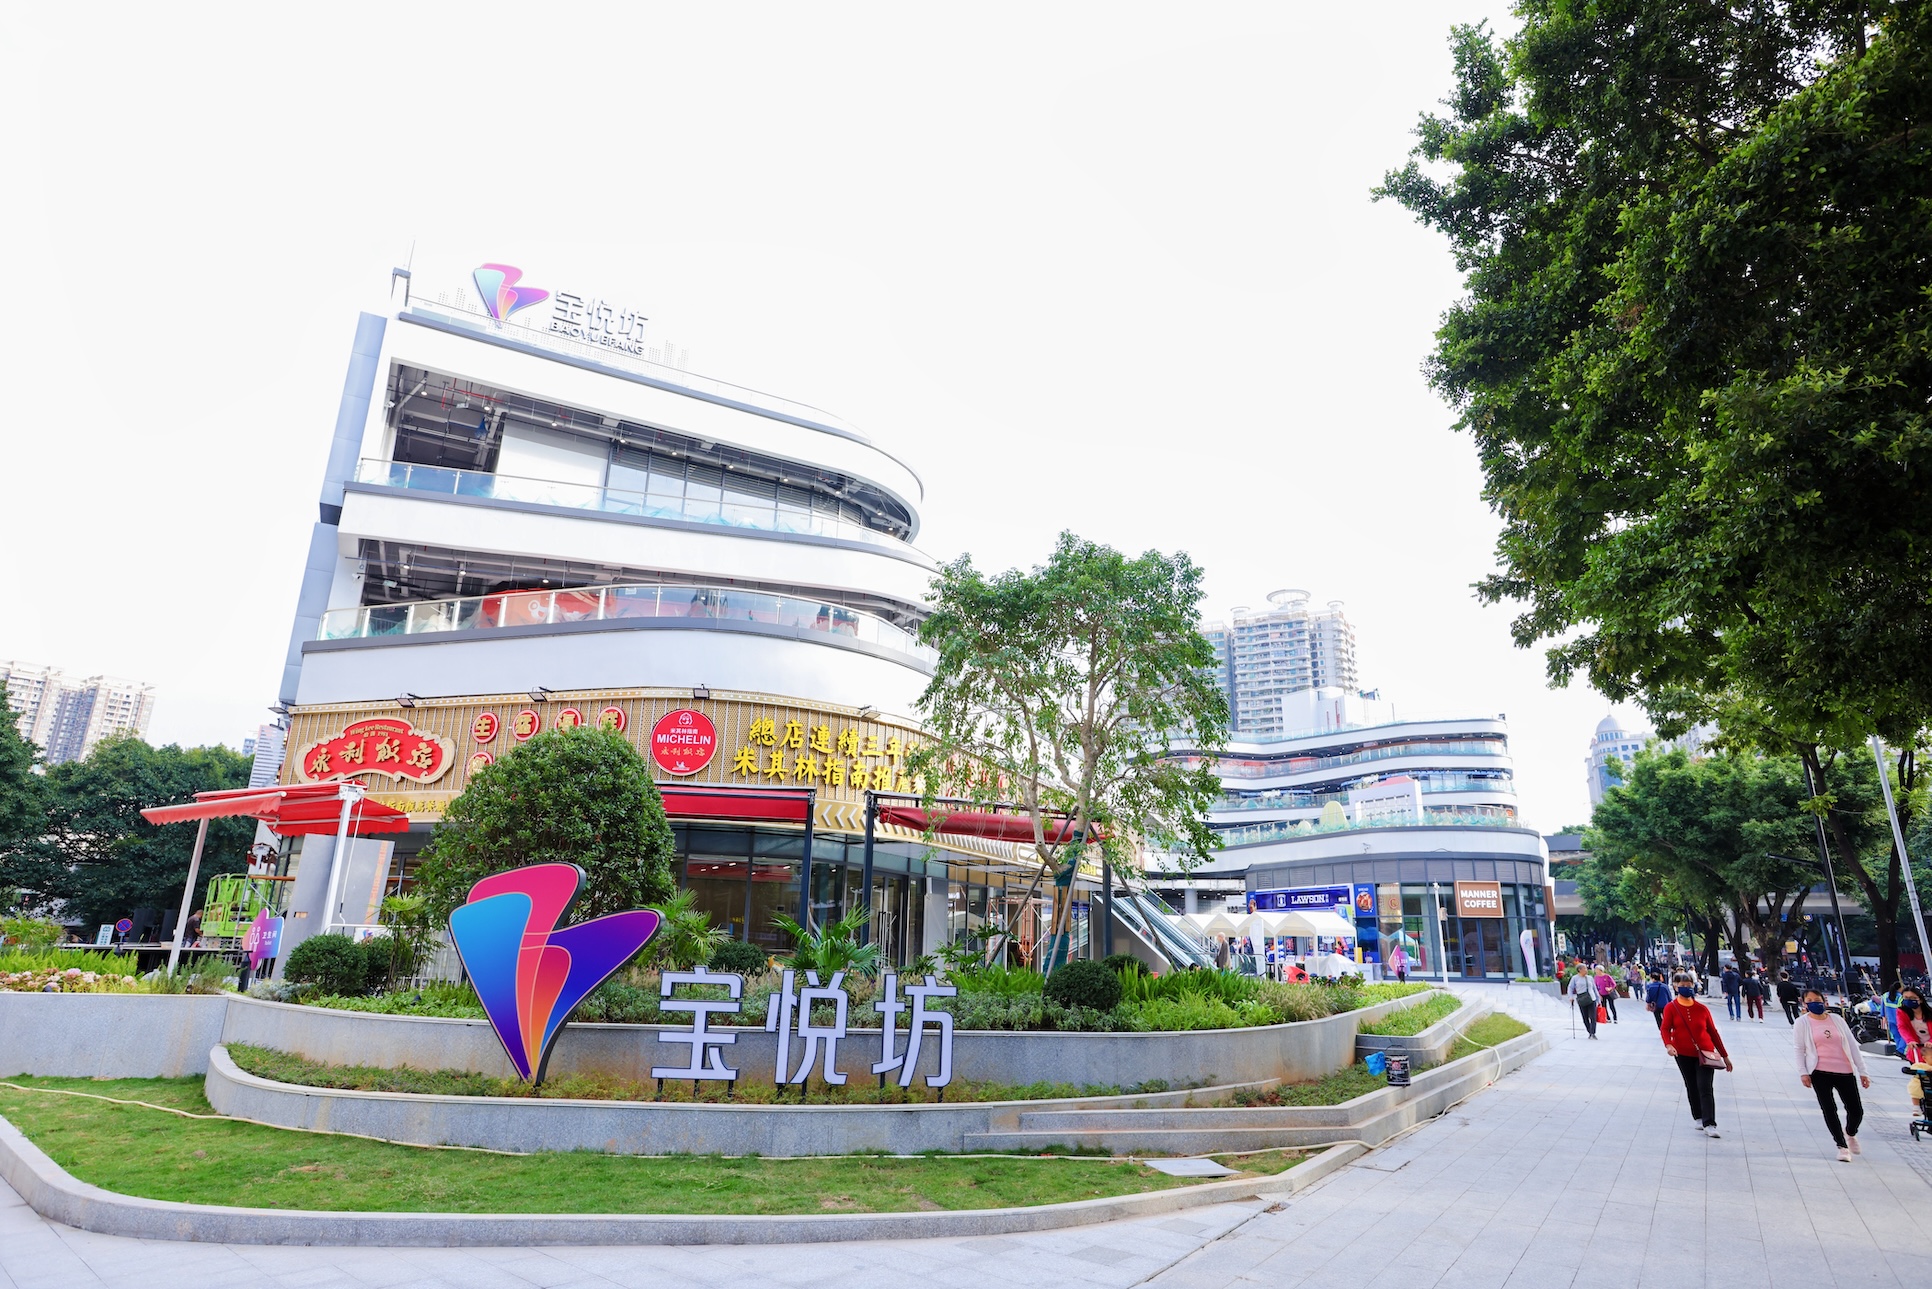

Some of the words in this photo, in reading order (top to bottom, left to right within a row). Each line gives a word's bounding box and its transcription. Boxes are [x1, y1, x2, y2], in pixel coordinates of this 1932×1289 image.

[552, 289, 649, 343] 宝悦坊
[550, 321, 645, 355] BAOYUEFANG
[656, 734, 711, 745] MICHELIN
[1291, 894, 1325, 904] LAWSON
[1460, 890, 1498, 899] MANNER
[1464, 900, 1498, 908] COFFEE
[651, 965, 958, 1088] 宝悦坊
